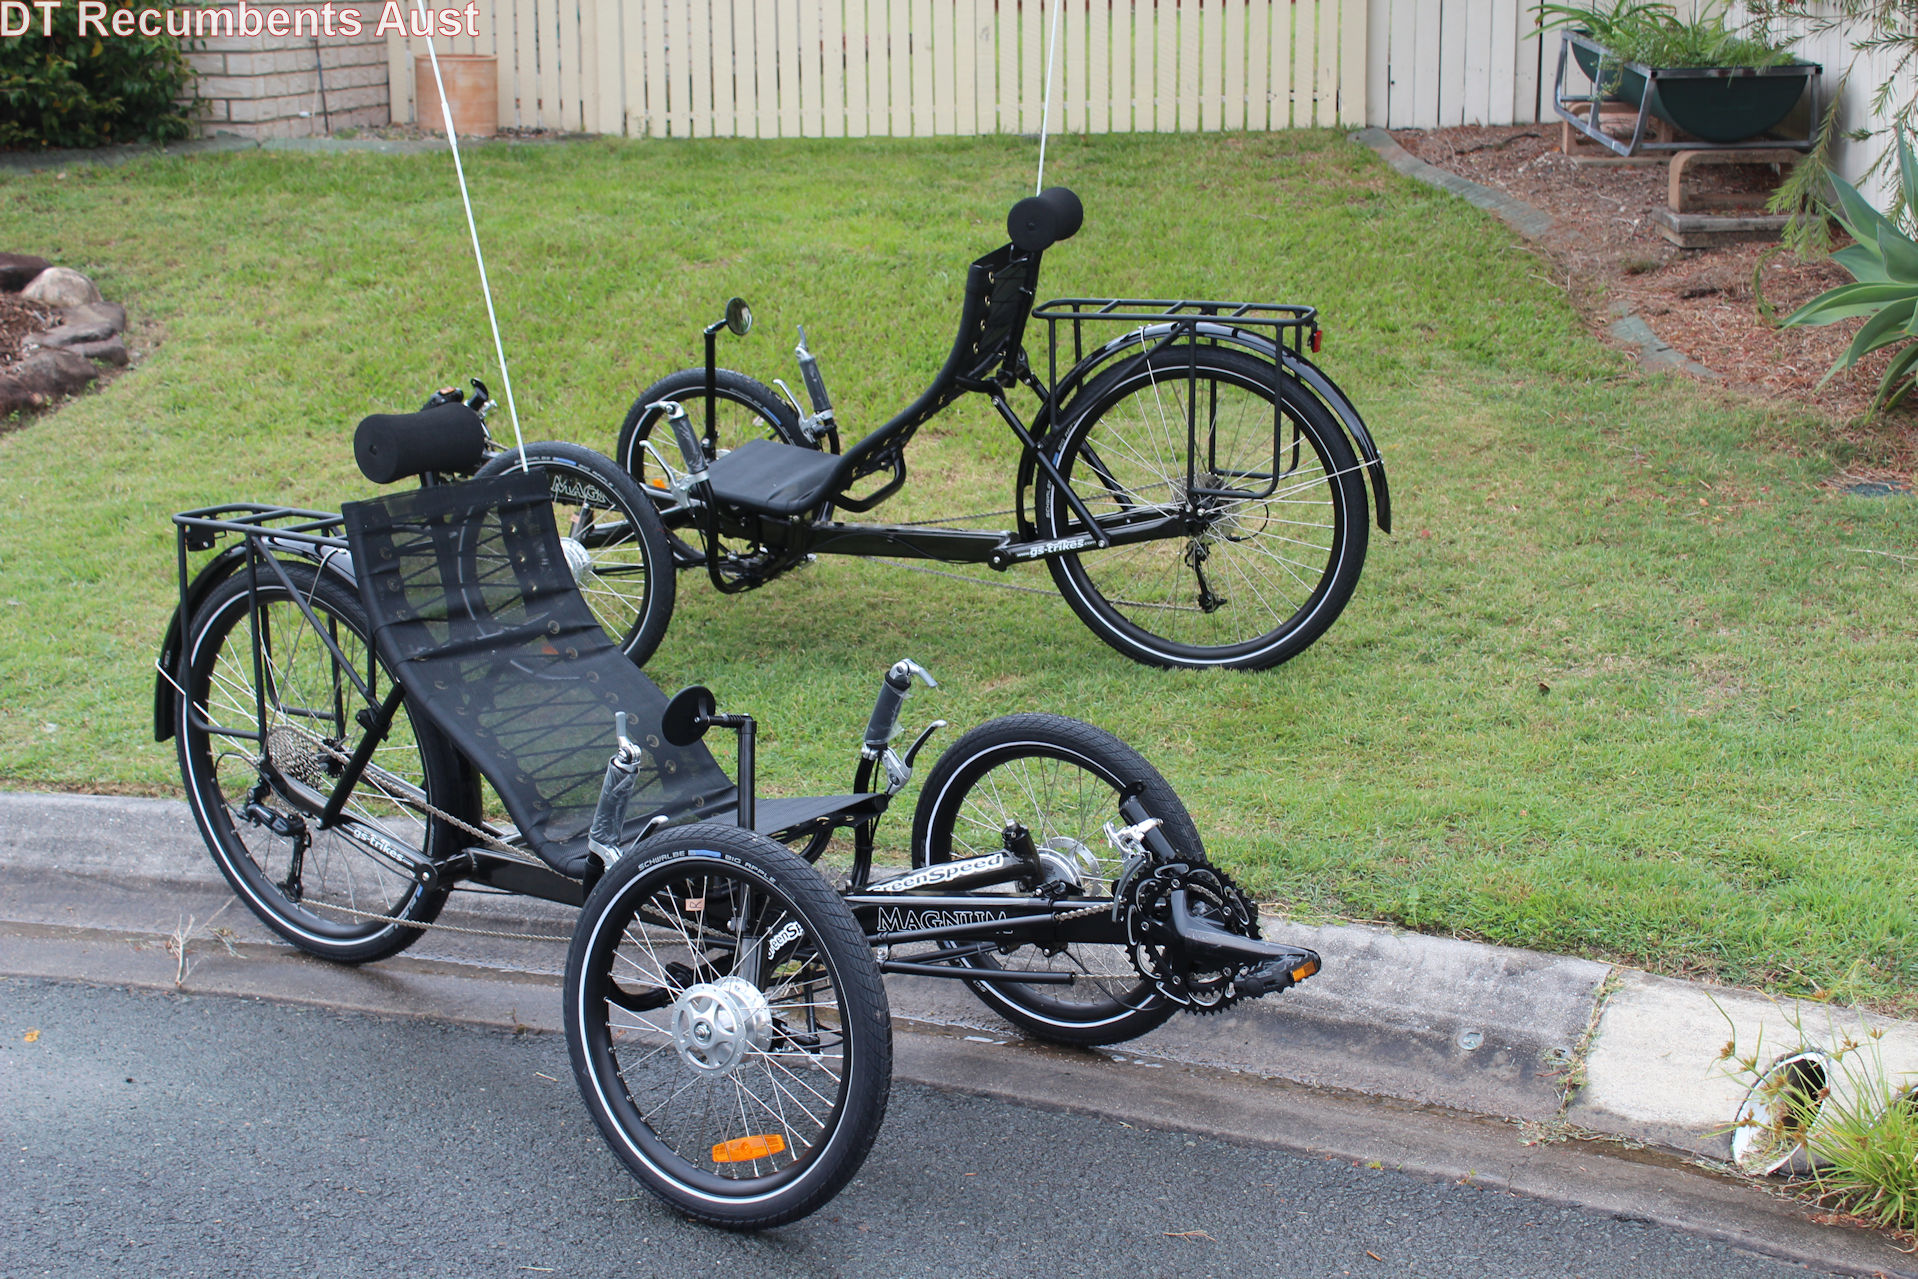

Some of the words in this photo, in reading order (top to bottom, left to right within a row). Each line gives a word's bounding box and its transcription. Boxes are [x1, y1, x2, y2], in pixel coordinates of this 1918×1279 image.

[637, 850, 685, 872] SCHWALBE
[724, 854, 741, 864] BIG
[744, 861, 776, 884] APPLE
